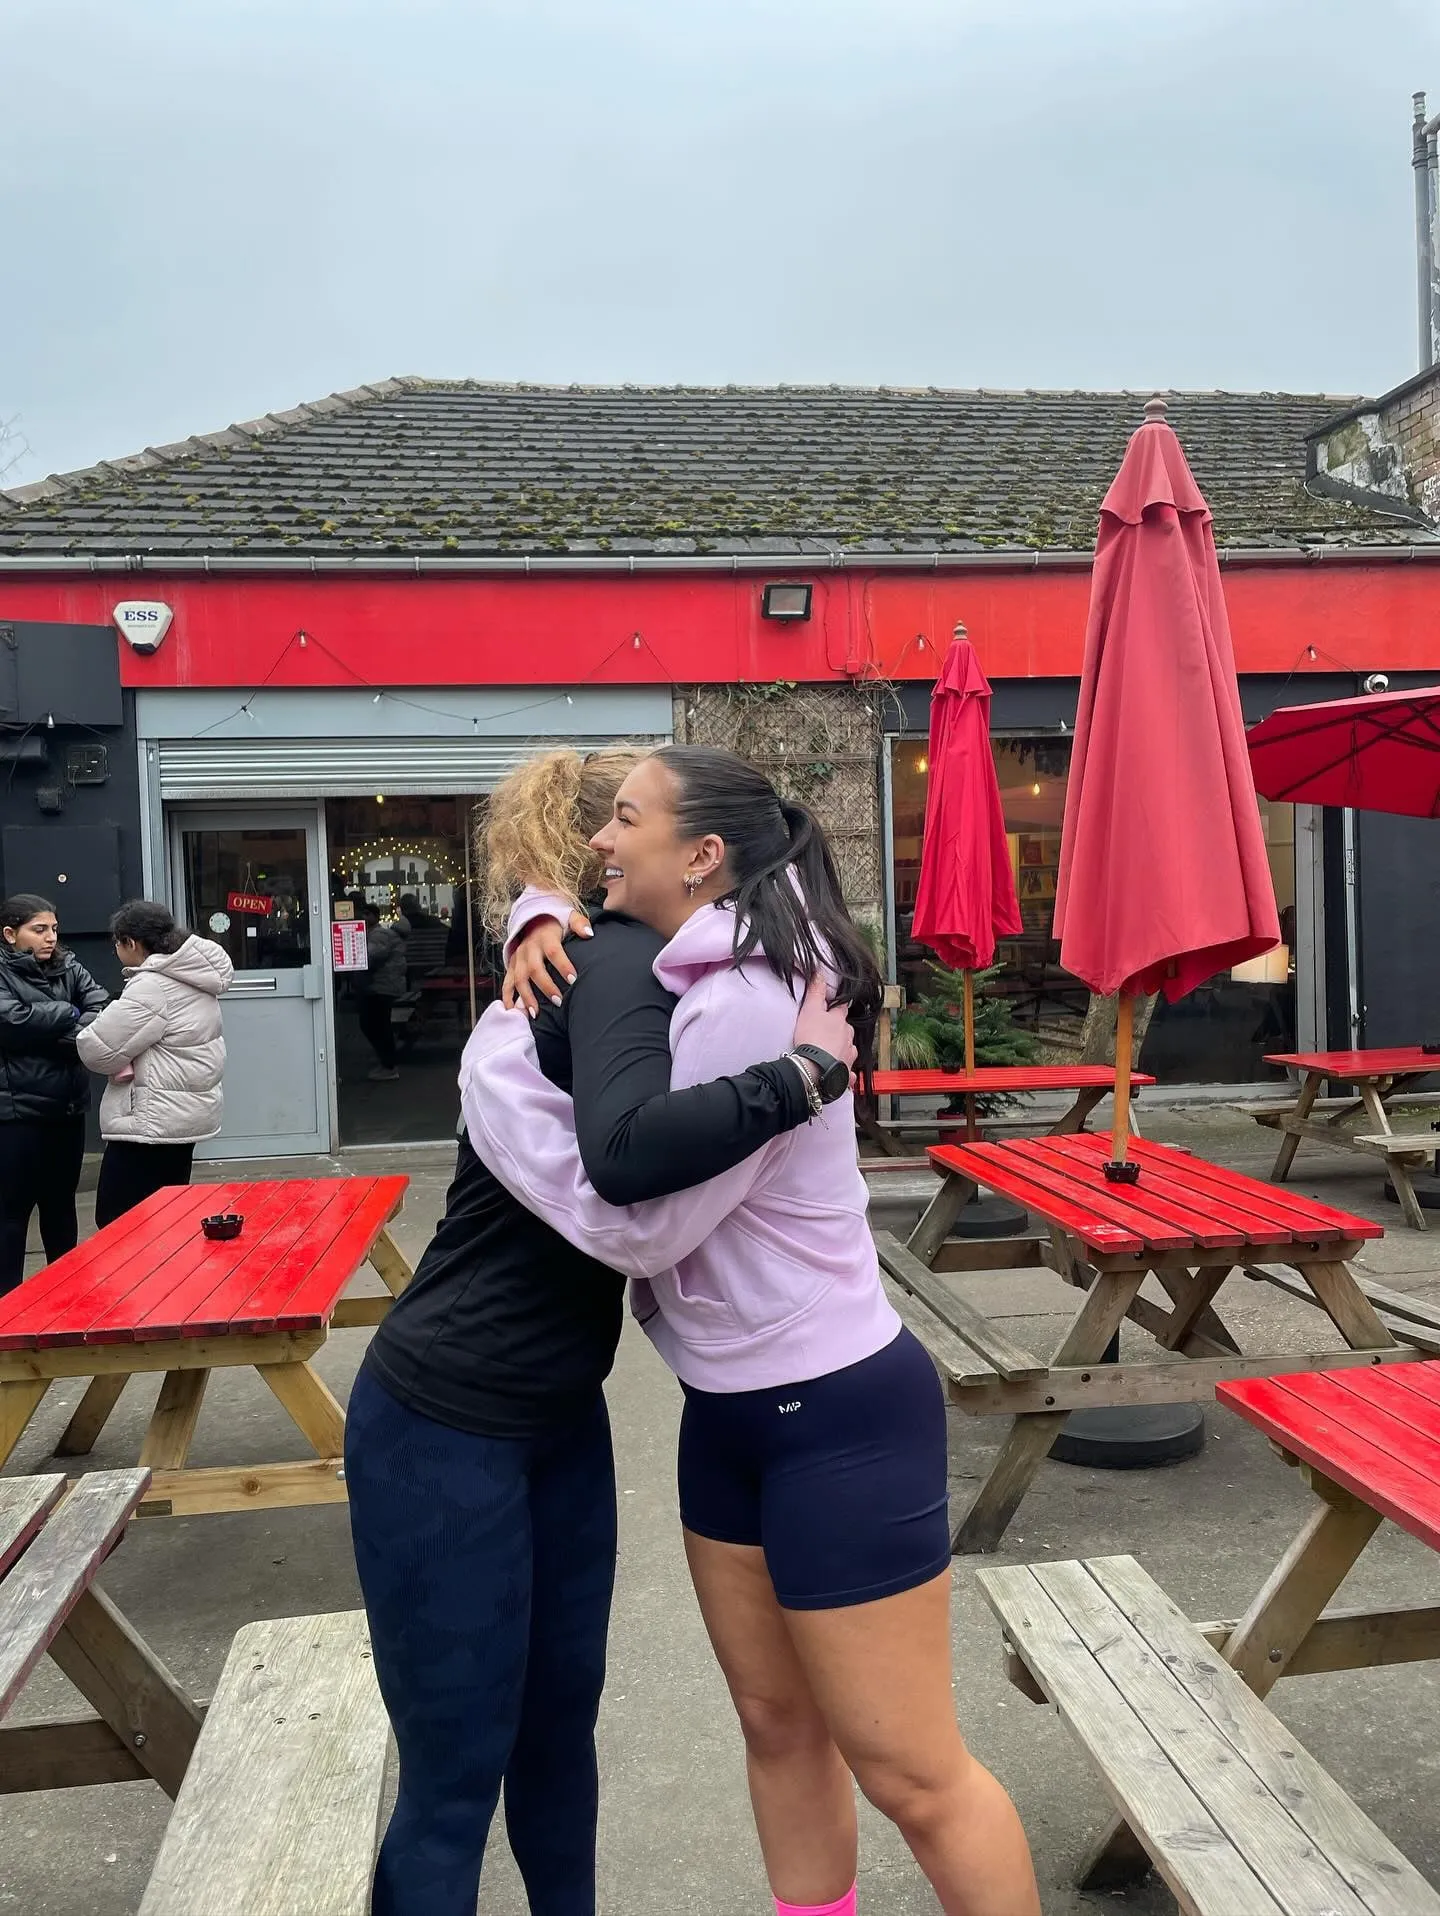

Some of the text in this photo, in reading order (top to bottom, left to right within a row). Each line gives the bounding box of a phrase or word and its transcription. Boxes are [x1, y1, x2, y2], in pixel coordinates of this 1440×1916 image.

[124, 611, 158, 621] ESS
[233, 896, 267, 911] OPEN
[778, 1401, 802, 1414] MP
